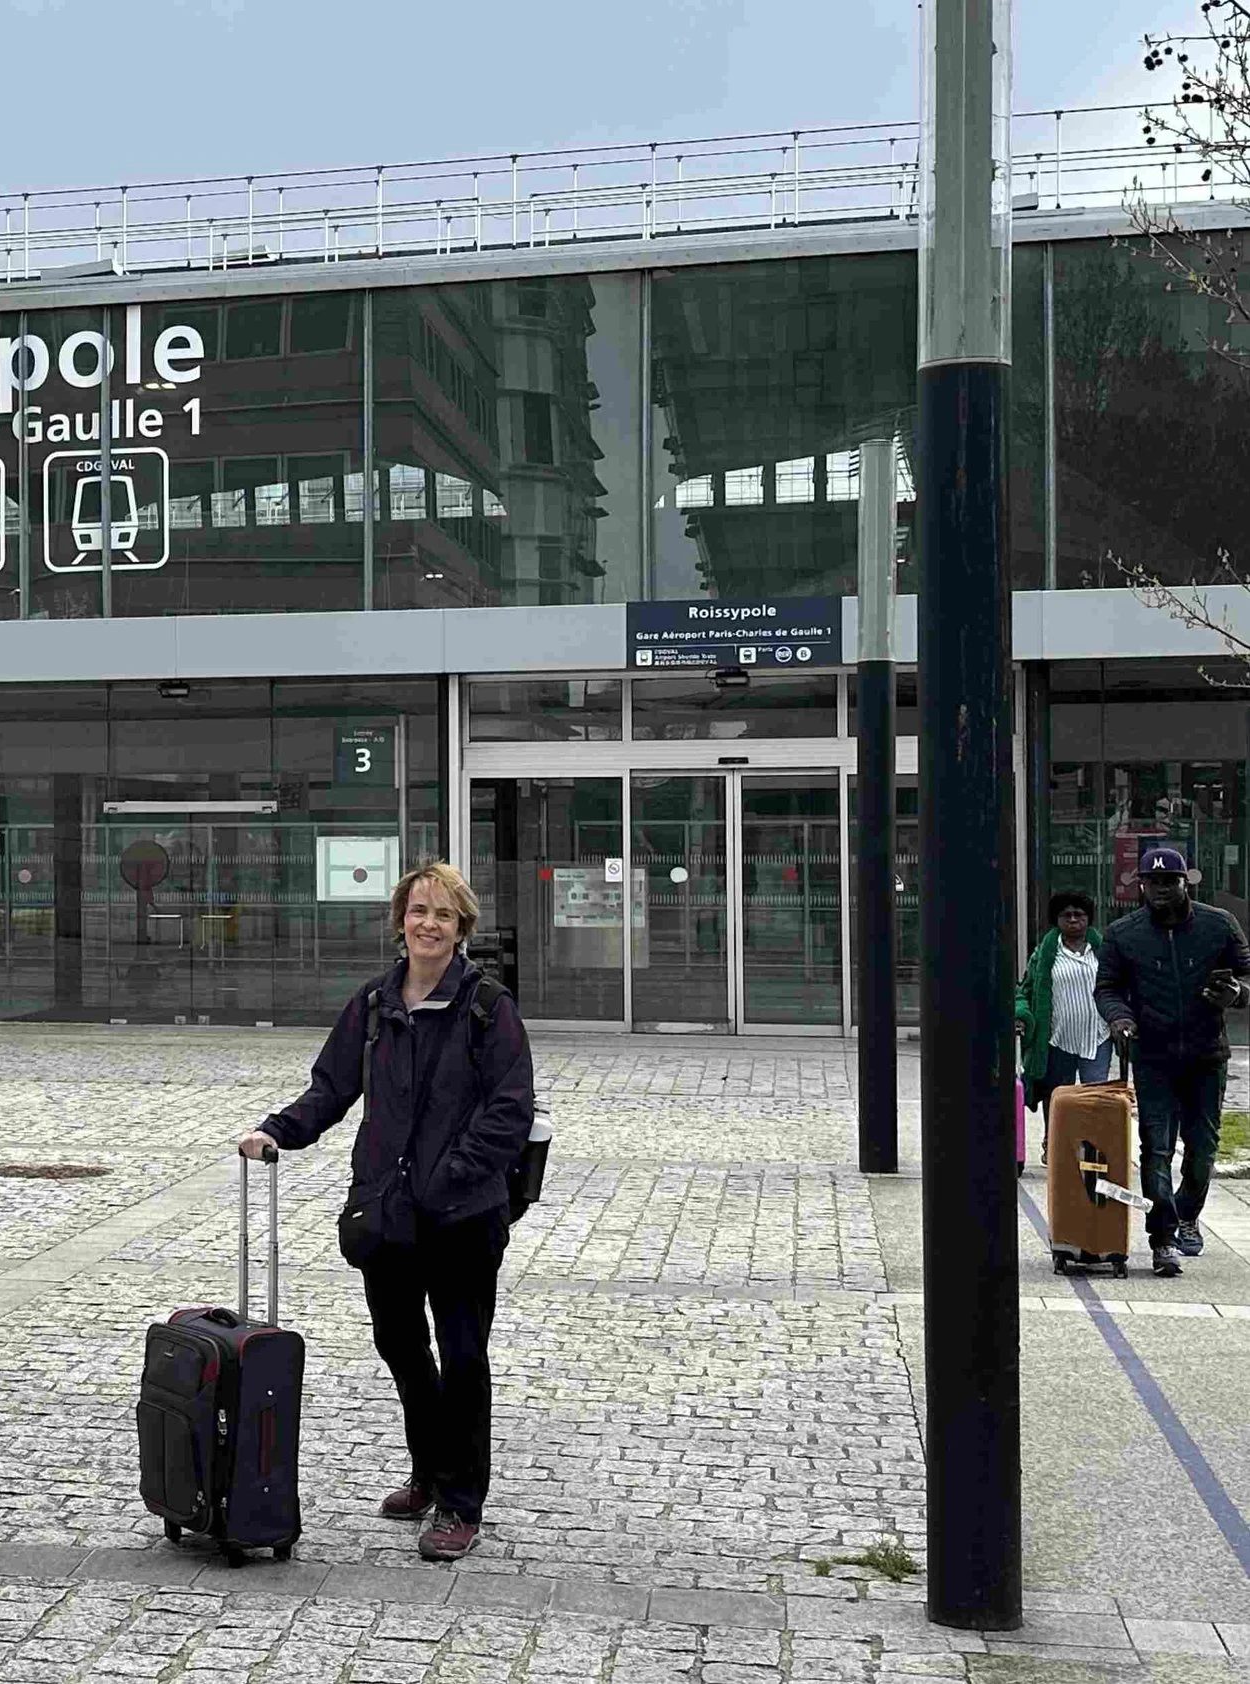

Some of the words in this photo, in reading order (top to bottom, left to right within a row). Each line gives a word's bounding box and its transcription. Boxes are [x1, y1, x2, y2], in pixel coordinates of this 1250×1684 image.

[12, 398, 164, 444] Gaulle
[182, 398, 200, 435] 1
[688, 604, 777, 620] Roissypole
[636, 632, 659, 640] Gare
[661, 631, 706, 640] Aéroport
[709, 628, 772, 638] Paris-Charles
[775, 628, 787, 636] de
[790, 626, 823, 636] Gaulle
[825, 627, 831, 635] 1
[355, 747, 371, 773] 3
[1152, 857, 1165, 869] M
